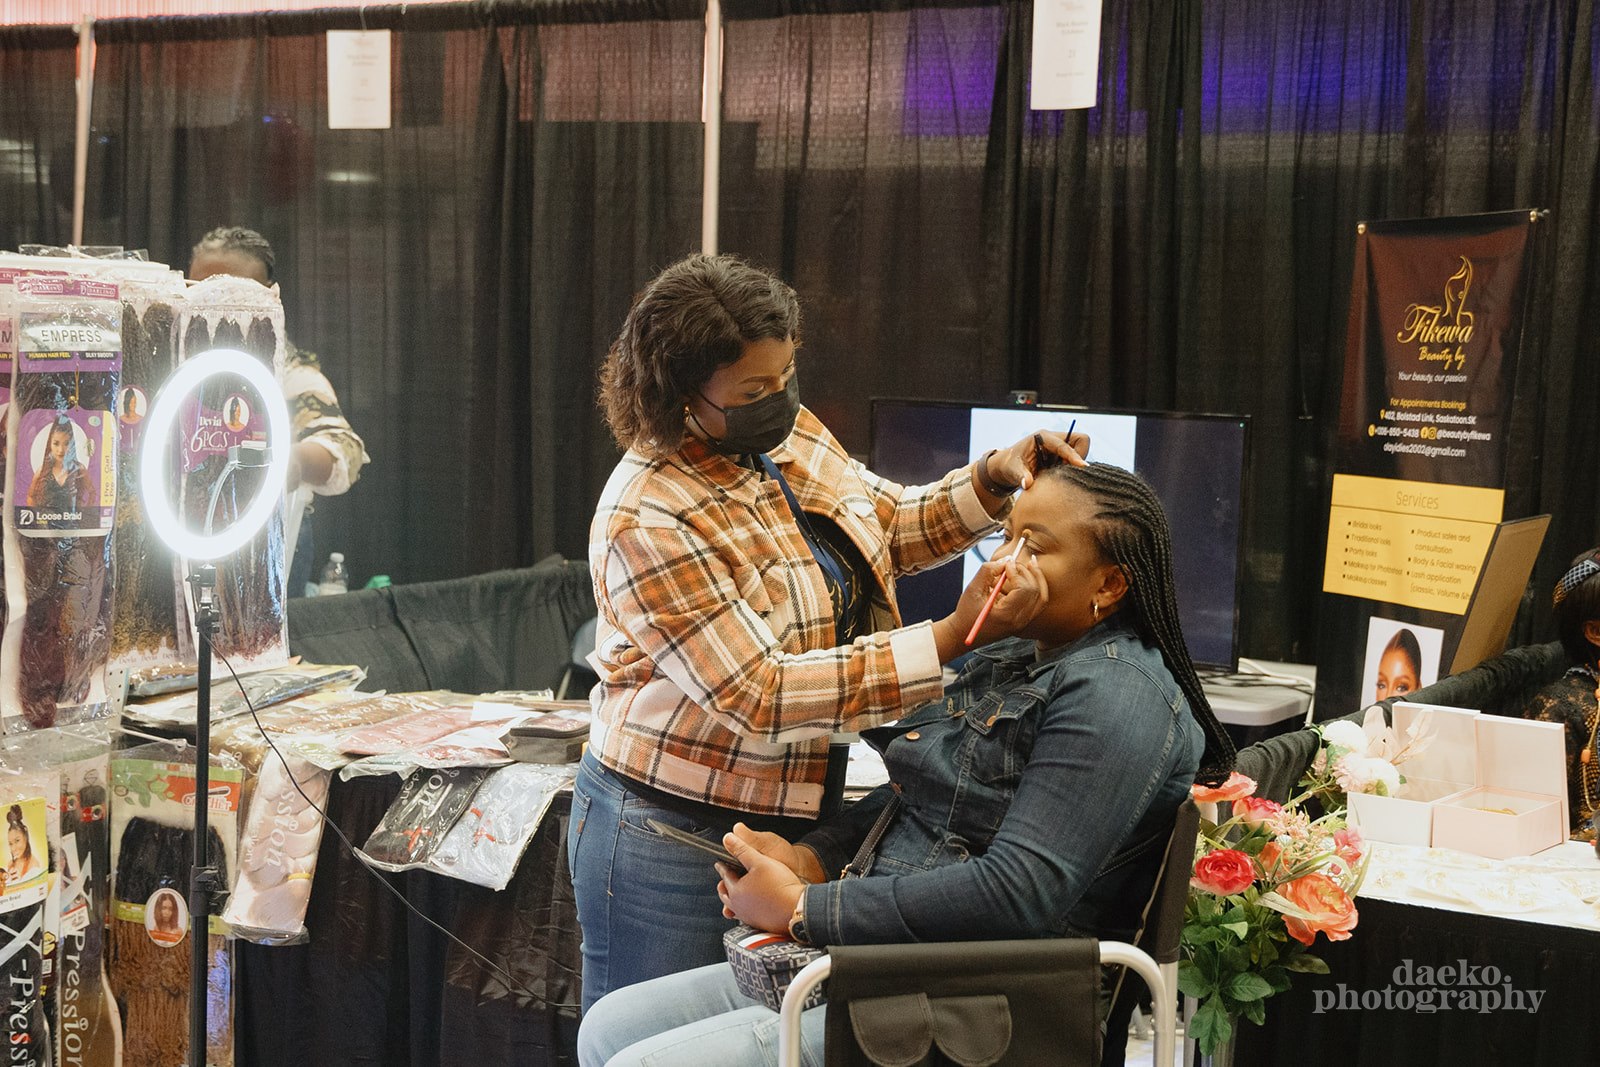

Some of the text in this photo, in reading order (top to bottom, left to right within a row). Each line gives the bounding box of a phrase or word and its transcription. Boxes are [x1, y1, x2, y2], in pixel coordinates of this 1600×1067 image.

[1397, 303, 1474, 343] Fikewa
[41, 330, 102, 343] EMPRESS
[1418, 346, 1466, 370] Beauty by
[1398, 371, 1412, 381] Your
[1434, 374, 1446, 382] our
[1444, 374, 1467, 384] passion
[1389, 398, 1466, 412] For Appointments Bookings
[1395, 490, 1439, 509] Services
[36, 511, 62, 520] Loose
[63, 511, 82, 520] Braid
[1417, 529, 1441, 538] Product
[1442, 532, 1457, 541] sales
[1414, 544, 1453, 554] consultation
[1413, 556, 1429, 567] Body
[1436, 560, 1455, 569] Facial
[1455, 563, 1477, 575] waxing
[1411, 571, 1462, 585] Lash application
[1437, 588, 1460, 599] Volume
